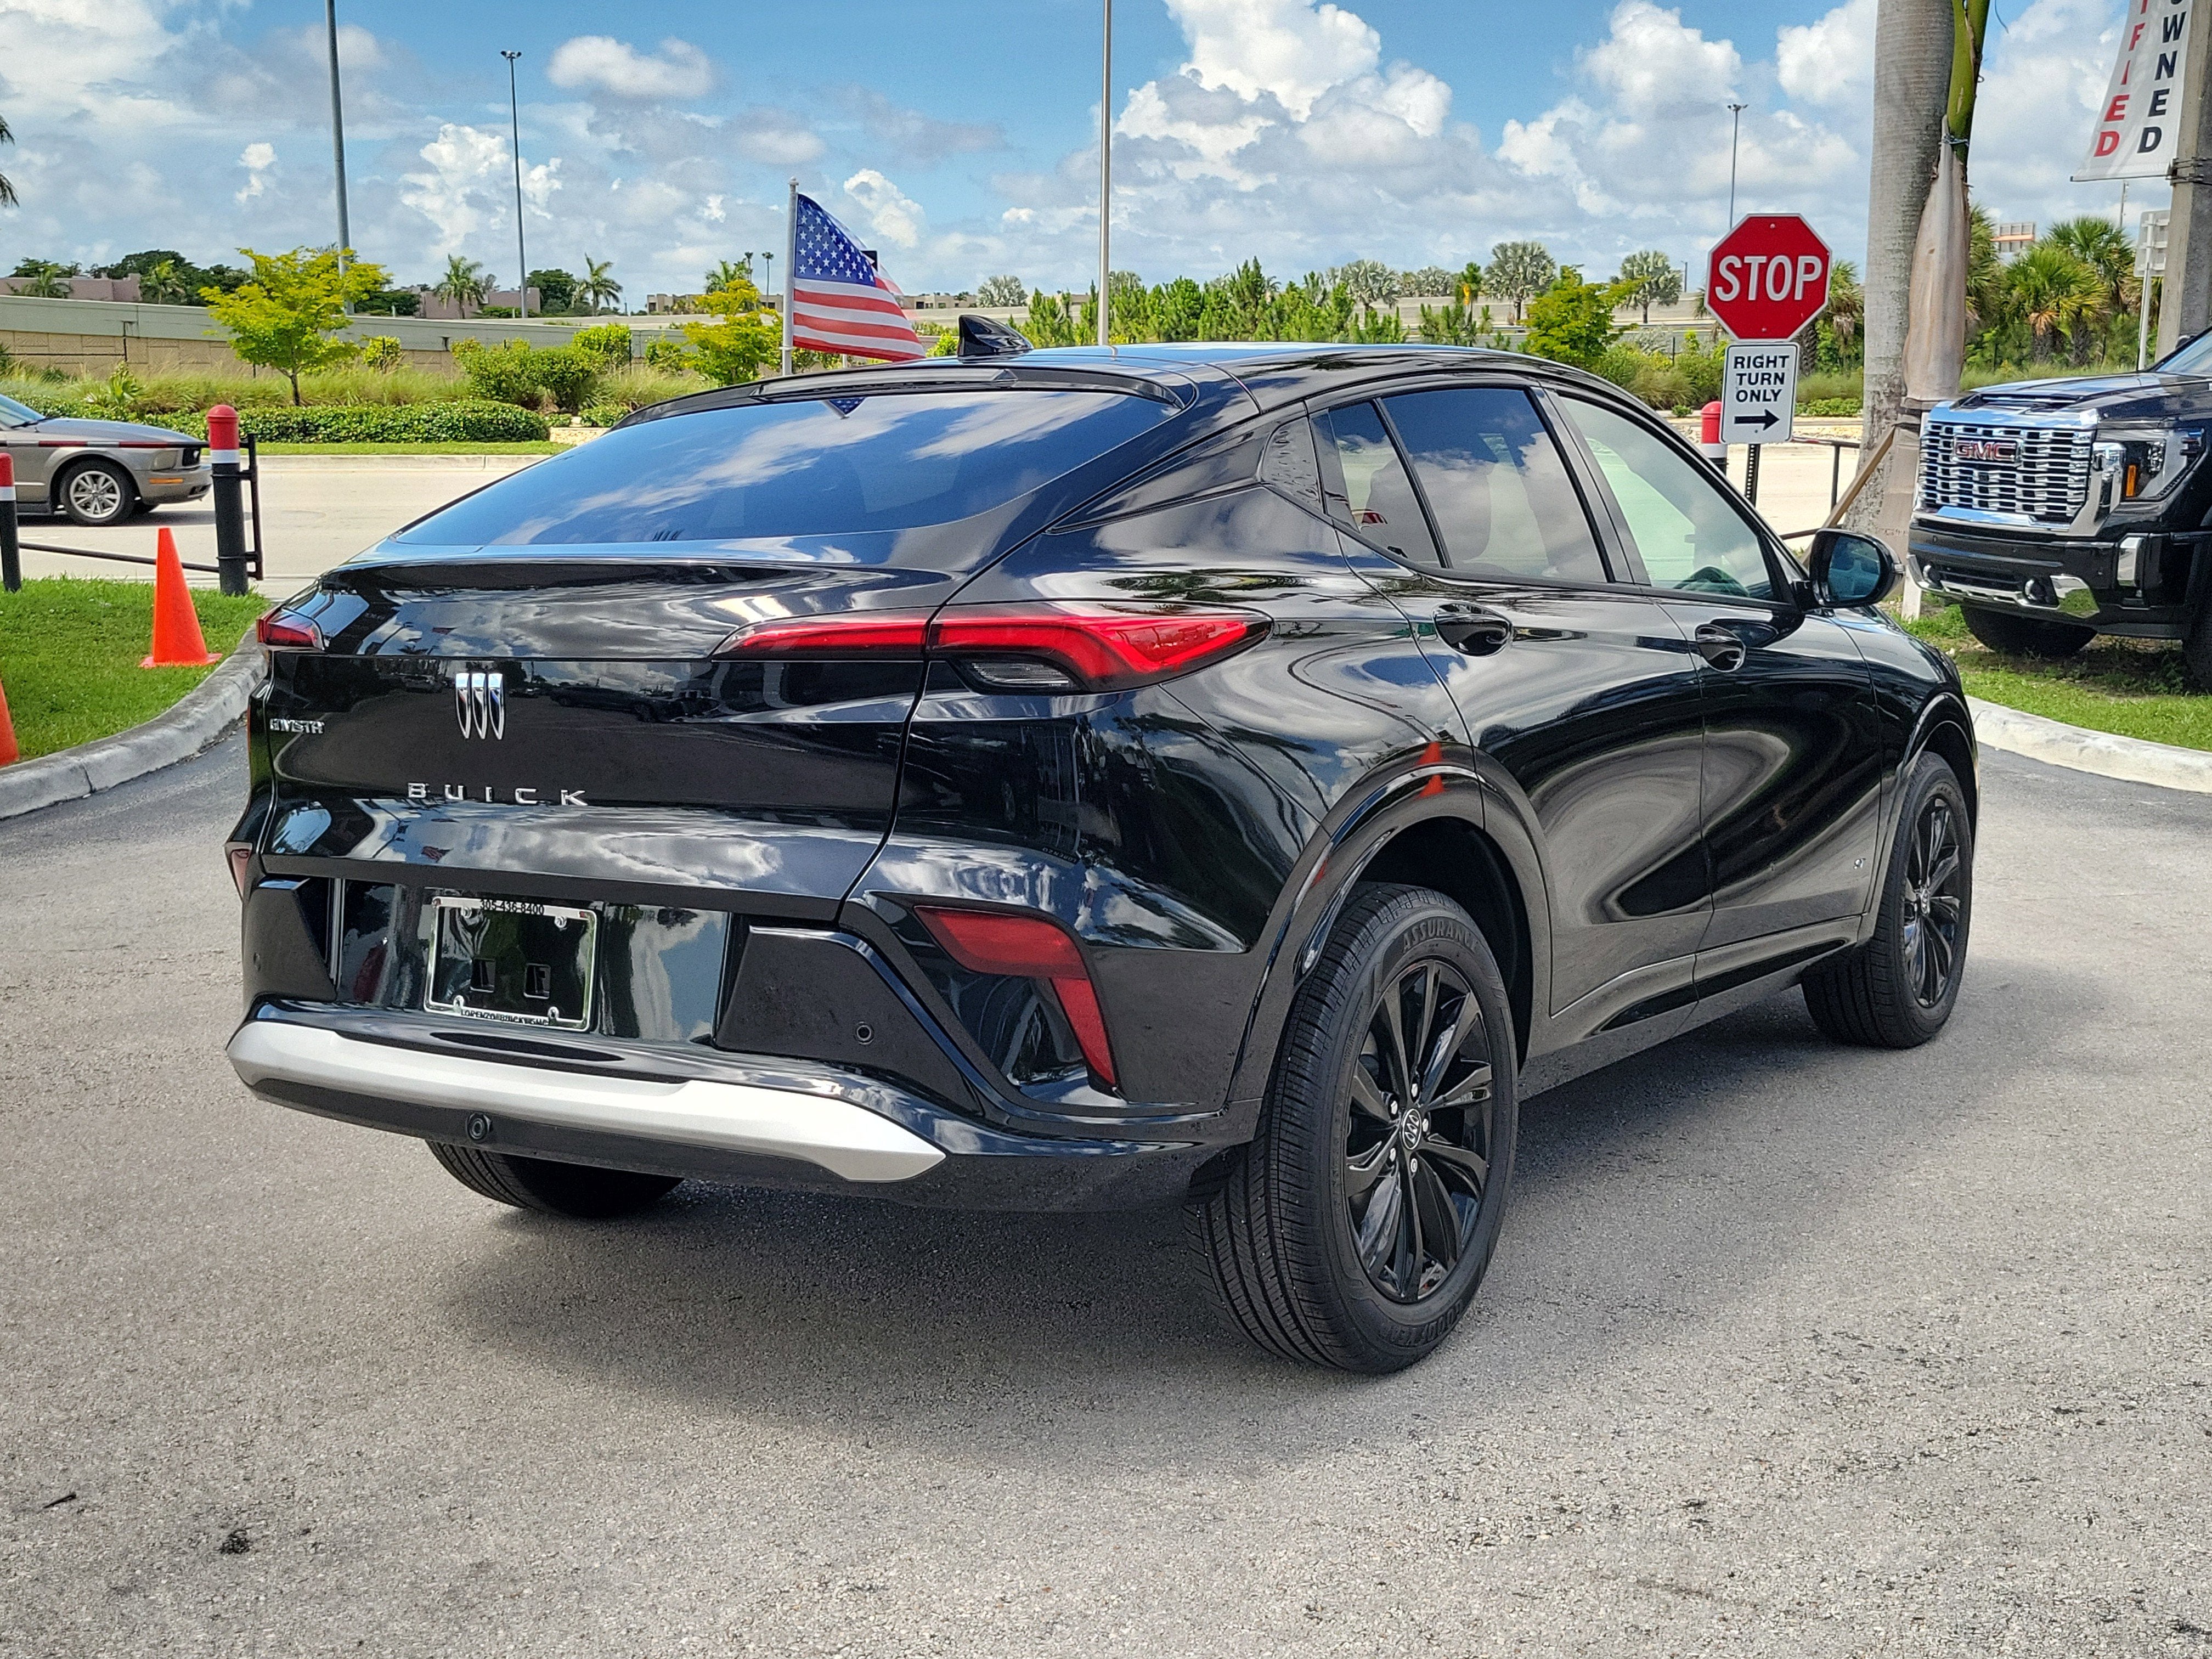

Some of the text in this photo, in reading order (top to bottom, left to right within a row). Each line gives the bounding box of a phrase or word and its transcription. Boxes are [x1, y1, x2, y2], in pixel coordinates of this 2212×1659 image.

[2137, 0, 2187, 154] WNED
[1714, 255, 1822, 302] STOP
[1733, 355, 1790, 369] RIGHT
[1735, 372, 1786, 385] TURN
[1735, 388, 1782, 403] ONLY
[1956, 440, 2016, 462] GMC
[407, 782, 589, 806] BUICK
[479, 899, 545, 916] 305-436-8400
[460, 1009, 496, 1020] LORENZO
